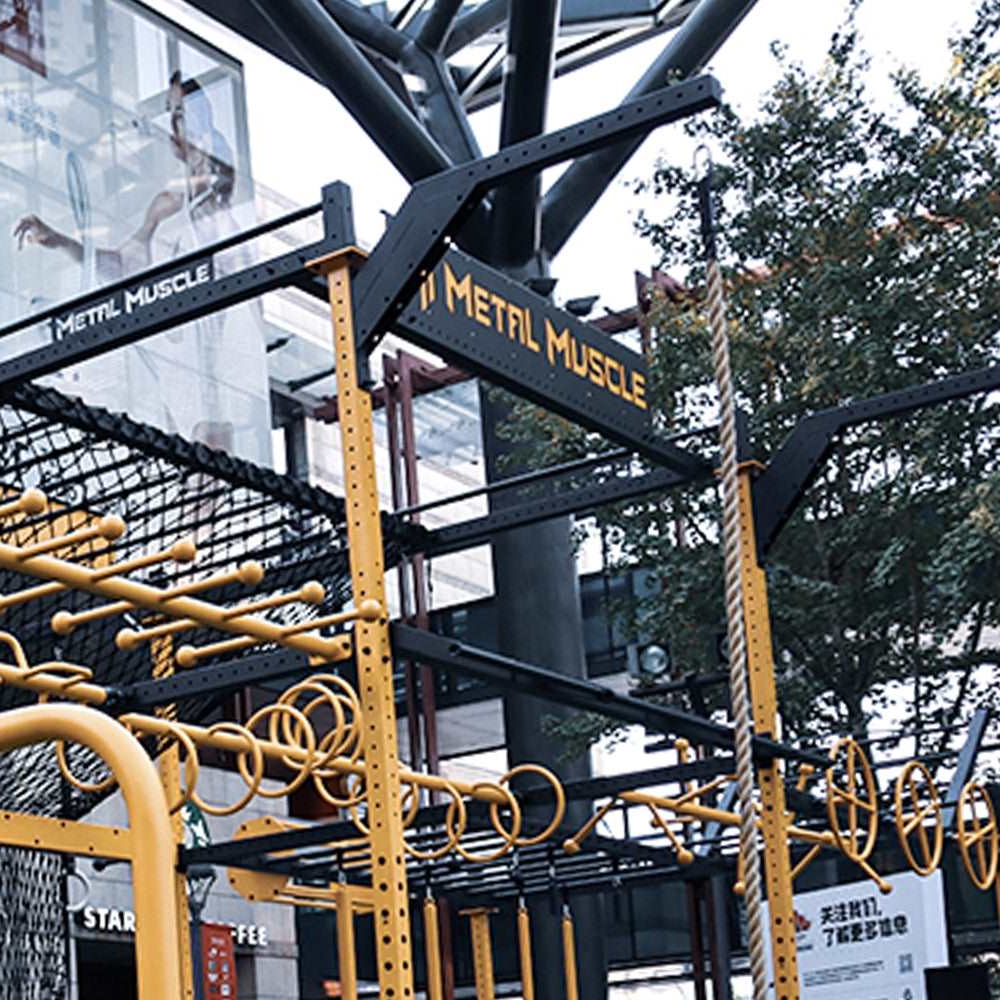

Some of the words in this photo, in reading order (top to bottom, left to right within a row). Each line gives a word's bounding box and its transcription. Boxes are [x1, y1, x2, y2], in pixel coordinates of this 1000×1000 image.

[55, 299, 121, 341] METAL
[124, 262, 210, 314] MUSCLE
[443, 261, 541, 354] METAL
[544, 317, 648, 411] MUSCLE
